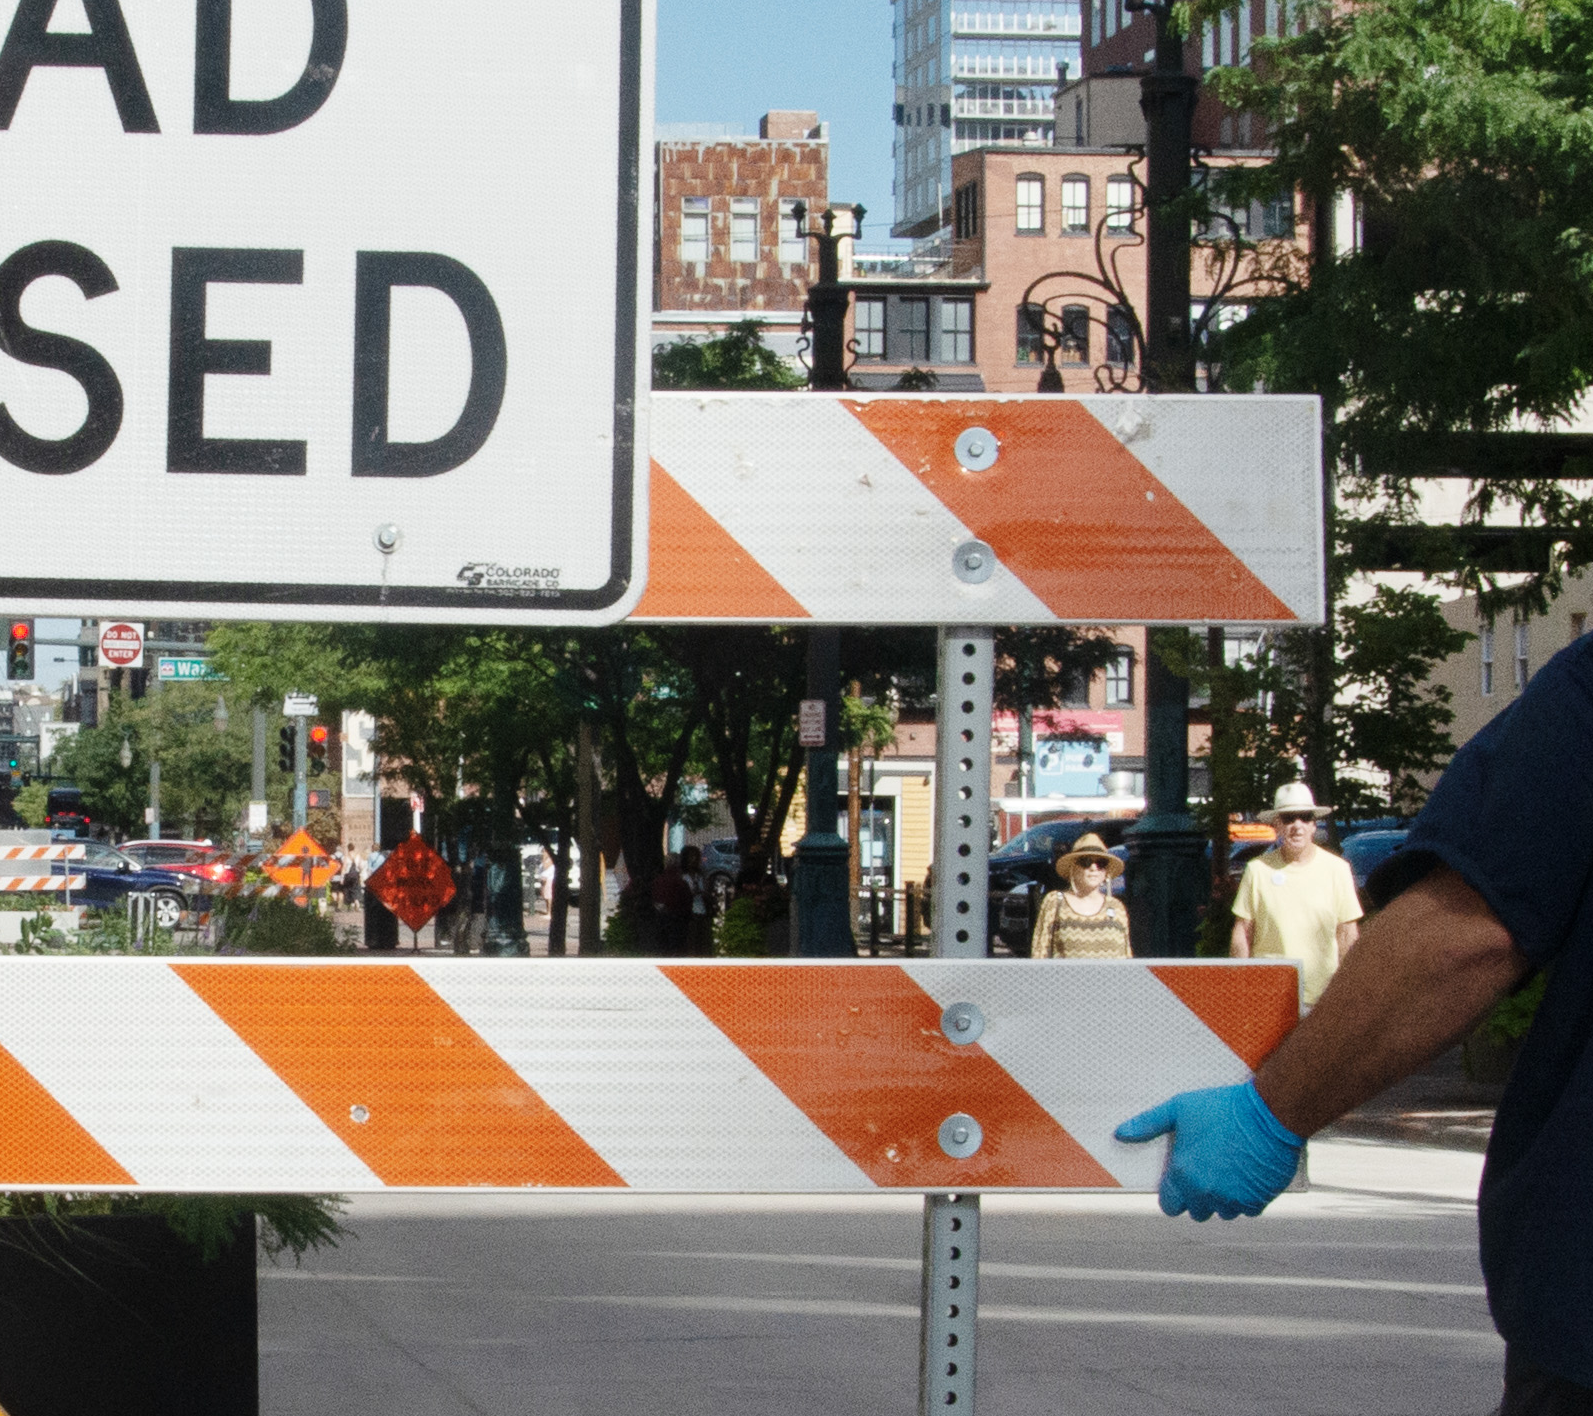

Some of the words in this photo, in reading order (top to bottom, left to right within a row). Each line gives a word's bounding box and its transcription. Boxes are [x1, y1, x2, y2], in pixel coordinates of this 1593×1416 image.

[485, 567, 560, 578] COLORADO
[106, 630, 118, 639] DO
[120, 631, 137, 639] NOT
[108, 649, 134, 659] ENTER
